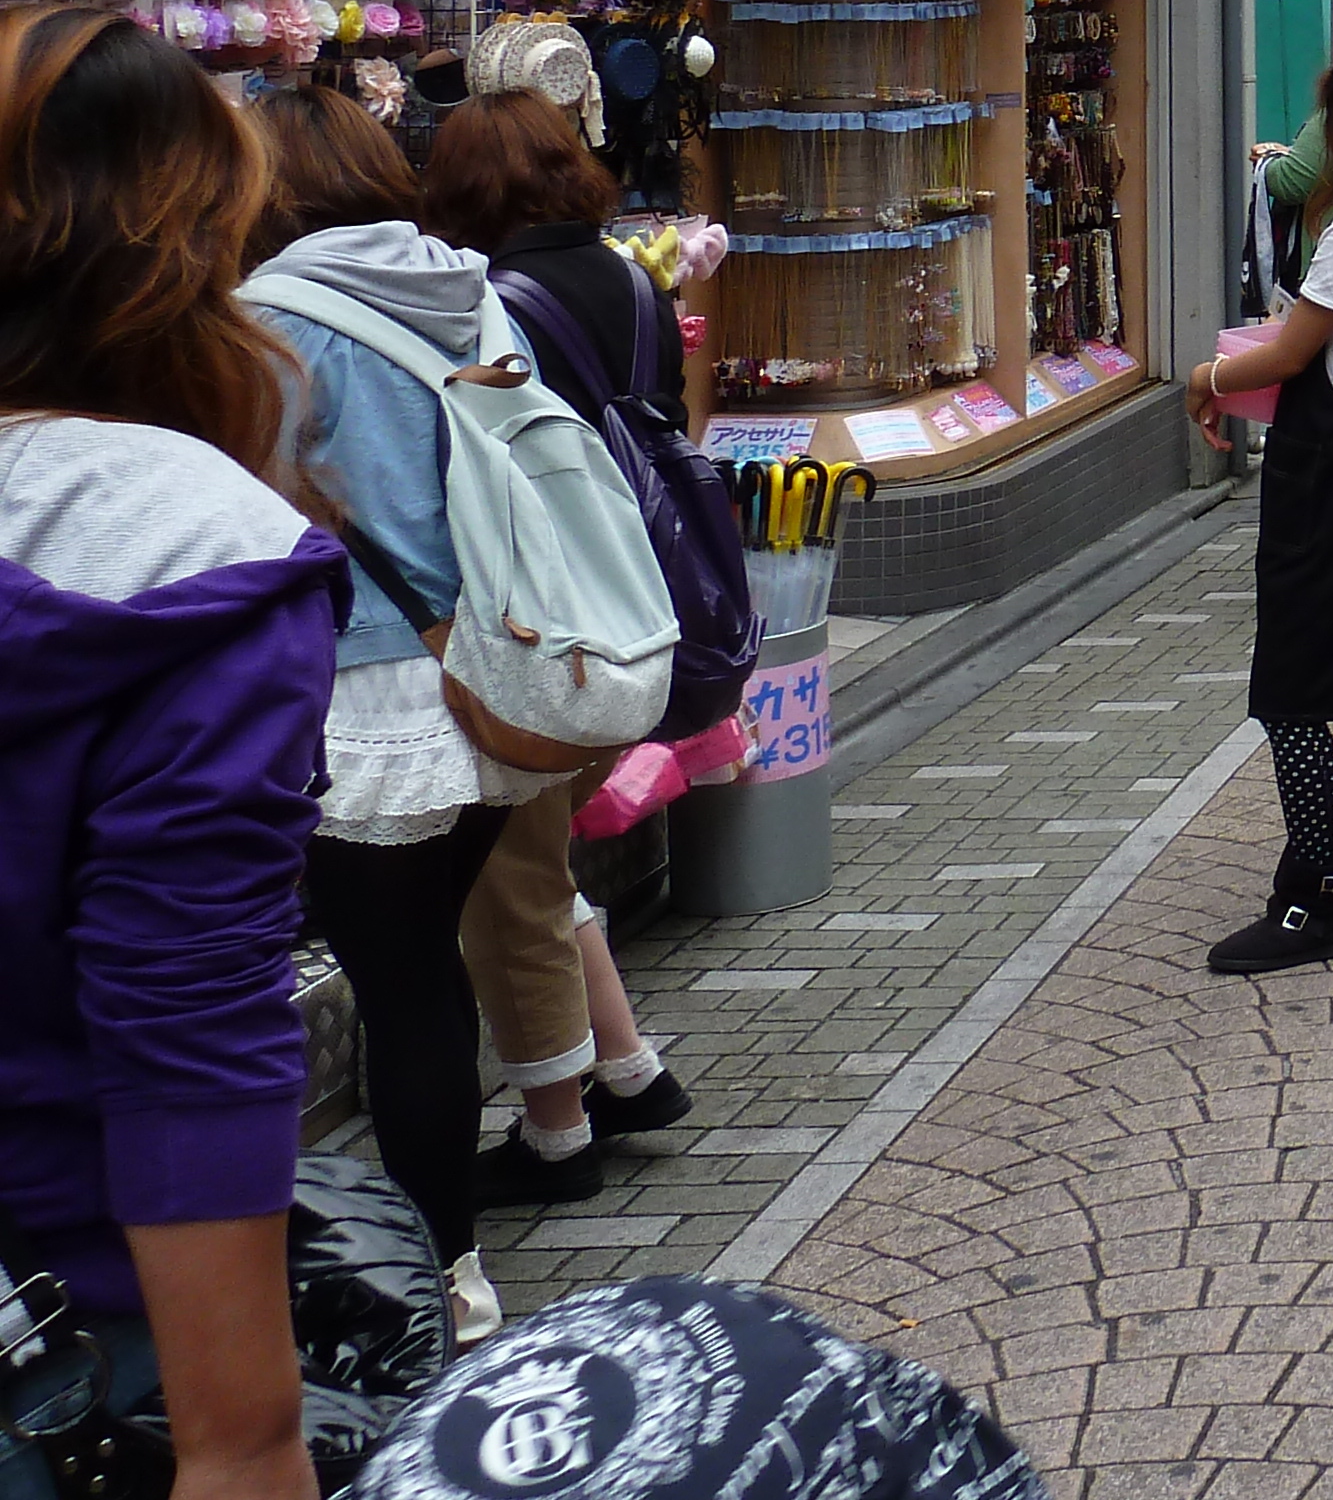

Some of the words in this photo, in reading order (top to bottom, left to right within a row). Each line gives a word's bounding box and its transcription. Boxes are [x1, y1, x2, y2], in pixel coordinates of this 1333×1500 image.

[711, 427, 810, 445] アクセサリー
[748, 666, 820, 723] カサ
